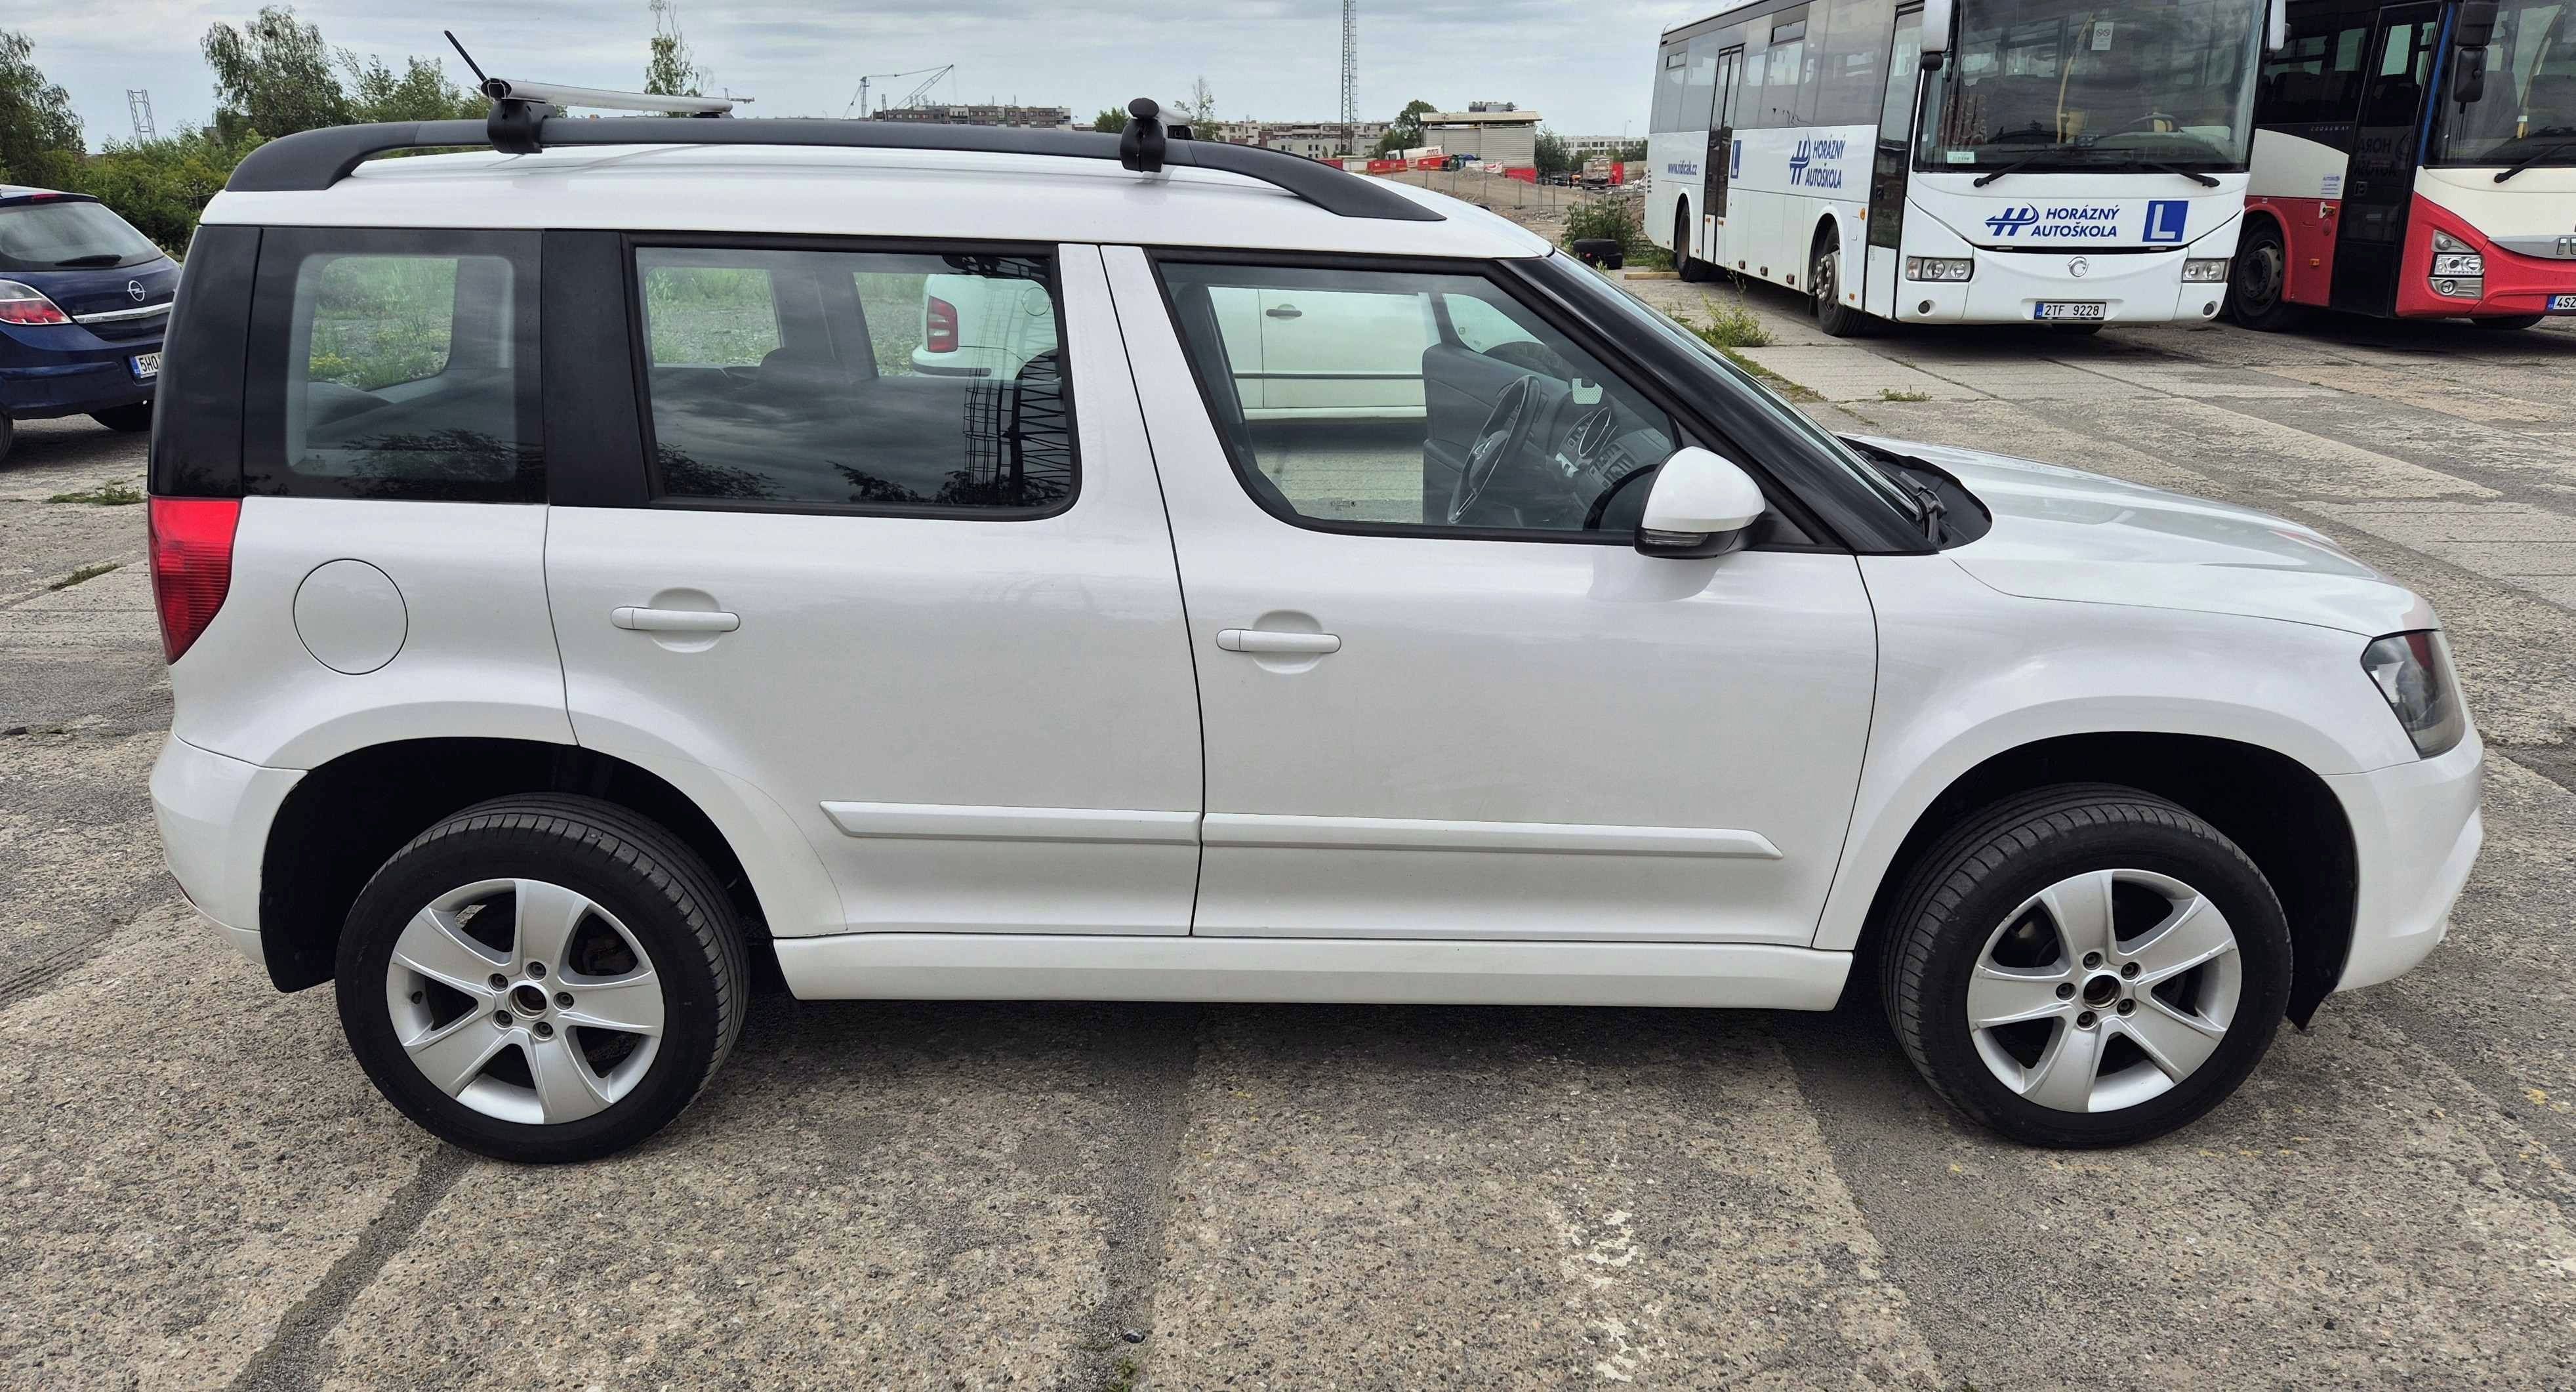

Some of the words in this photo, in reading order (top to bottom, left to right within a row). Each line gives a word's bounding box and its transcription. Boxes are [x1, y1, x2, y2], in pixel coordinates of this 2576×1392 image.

[1812, 133, 1846, 159] HORÁZNÝ
[1805, 162, 1842, 189] AUTOŠKOLA
[2045, 205, 2120, 220] HORÁZNÝ
[2150, 203, 2177, 239] L
[2030, 221, 2118, 237] AUTOŠKOLA
[2045, 305, 2066, 316] 2TF
[2072, 305, 2100, 316] 9228
